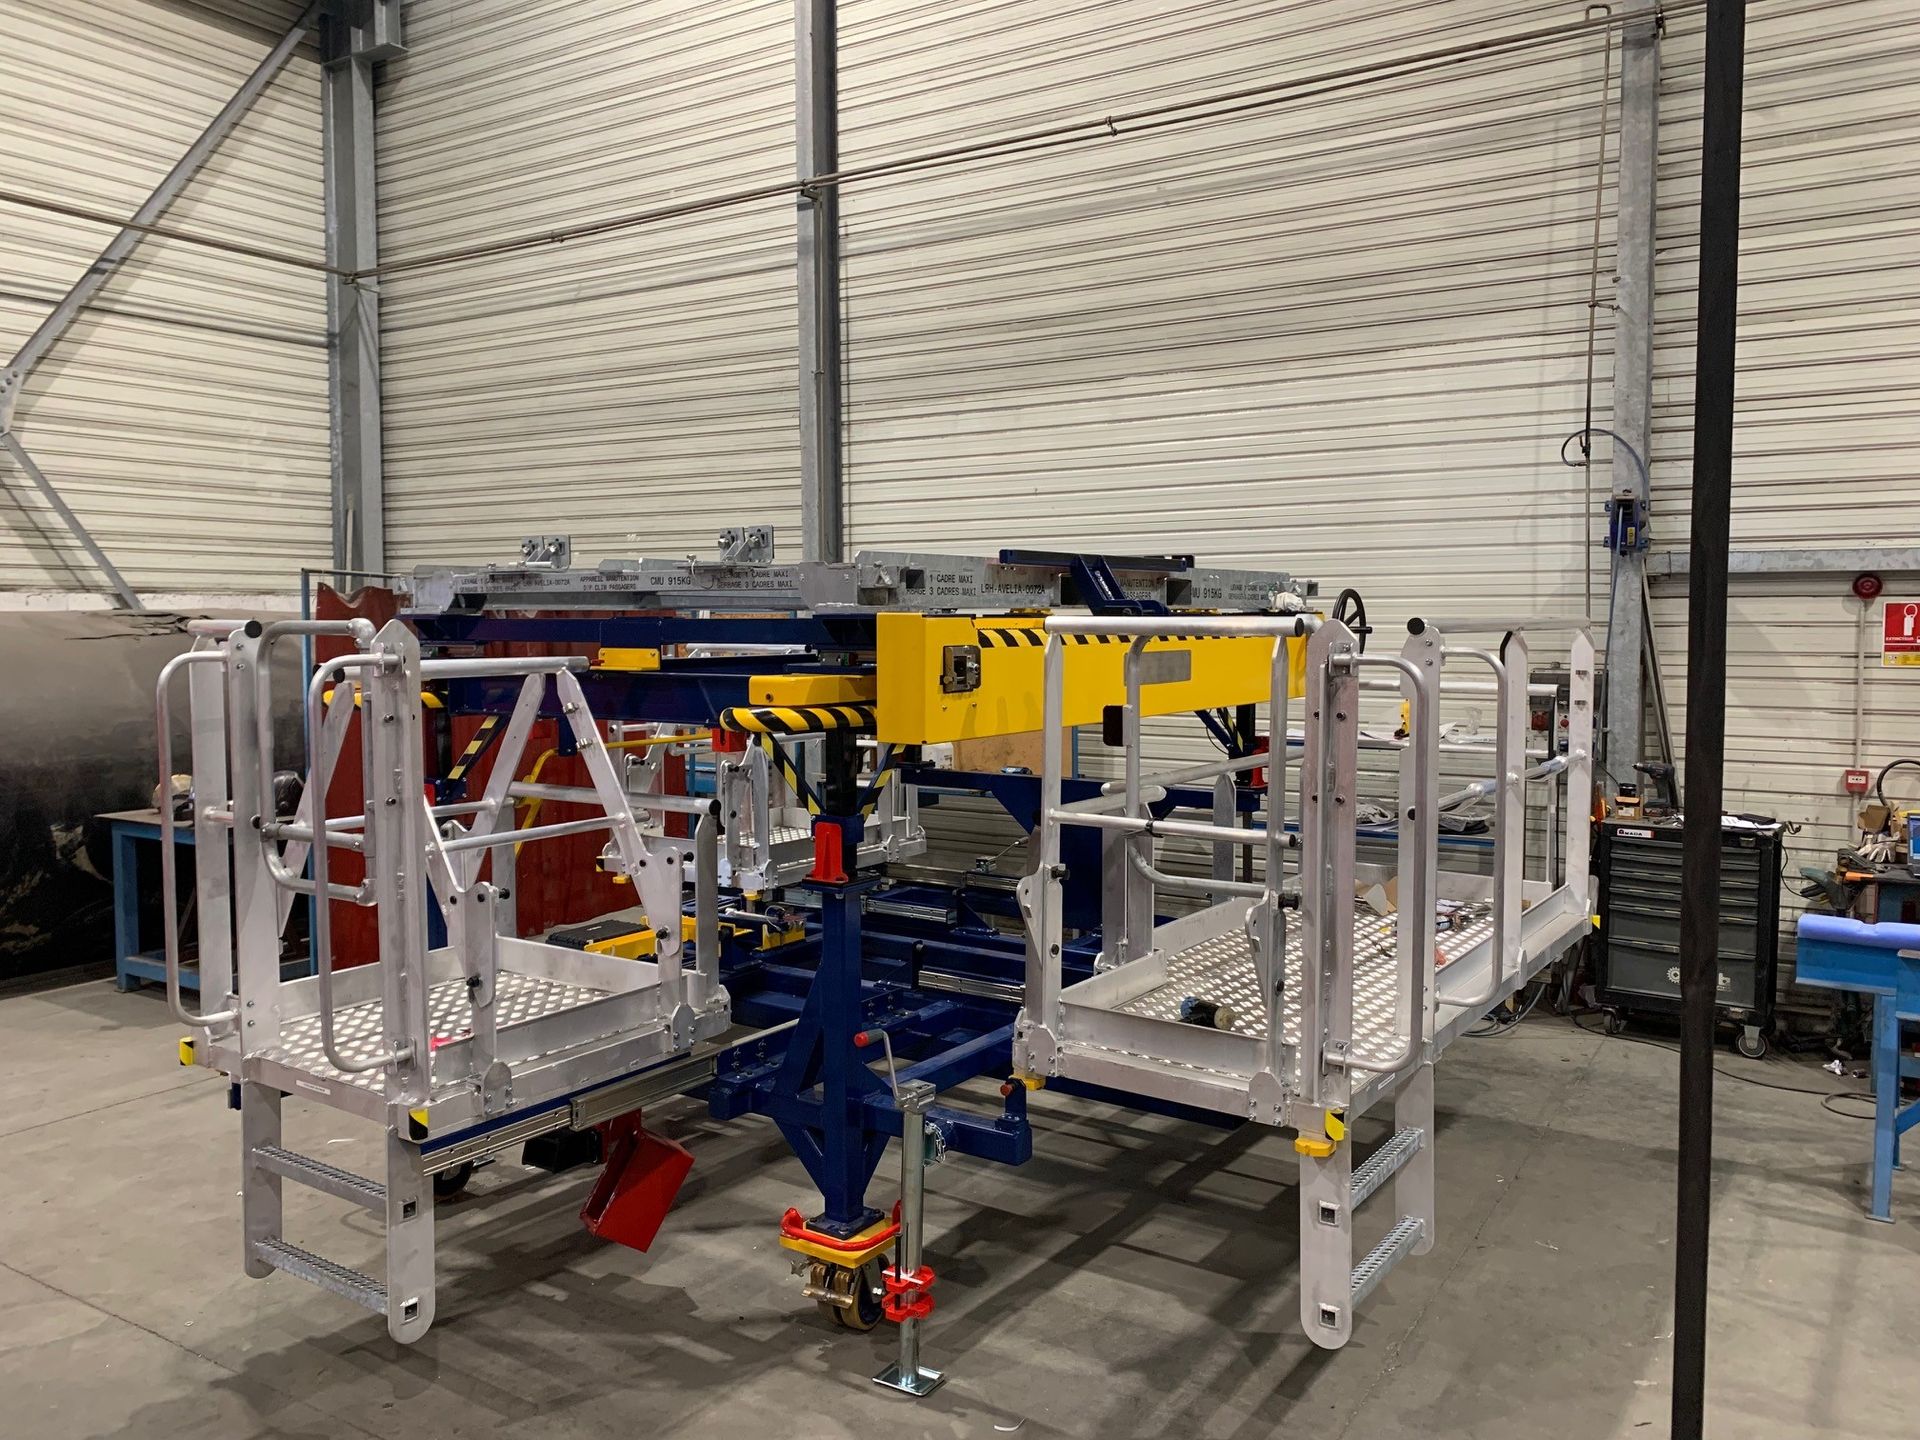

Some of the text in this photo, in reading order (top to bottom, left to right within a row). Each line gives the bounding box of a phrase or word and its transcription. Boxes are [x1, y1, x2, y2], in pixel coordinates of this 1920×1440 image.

[752, 570, 770, 578] CADRE
[773, 570, 788, 578] MAXI
[929, 574, 973, 584] 1 CADRE MAXI
[650, 576, 691, 586] CMU 915KG
[751, 580, 774, 588] CADRES
[777, 580, 792, 588] MAXI
[929, 587, 933, 596] 3
[936, 586, 959, 596] CADRES
[961, 587, 976, 597] MAXI
[980, 583, 1046, 595] LRH-AVELIA-0072A
[1191, 587, 1200, 599] MU
[1203, 587, 1222, 599] 915KG
